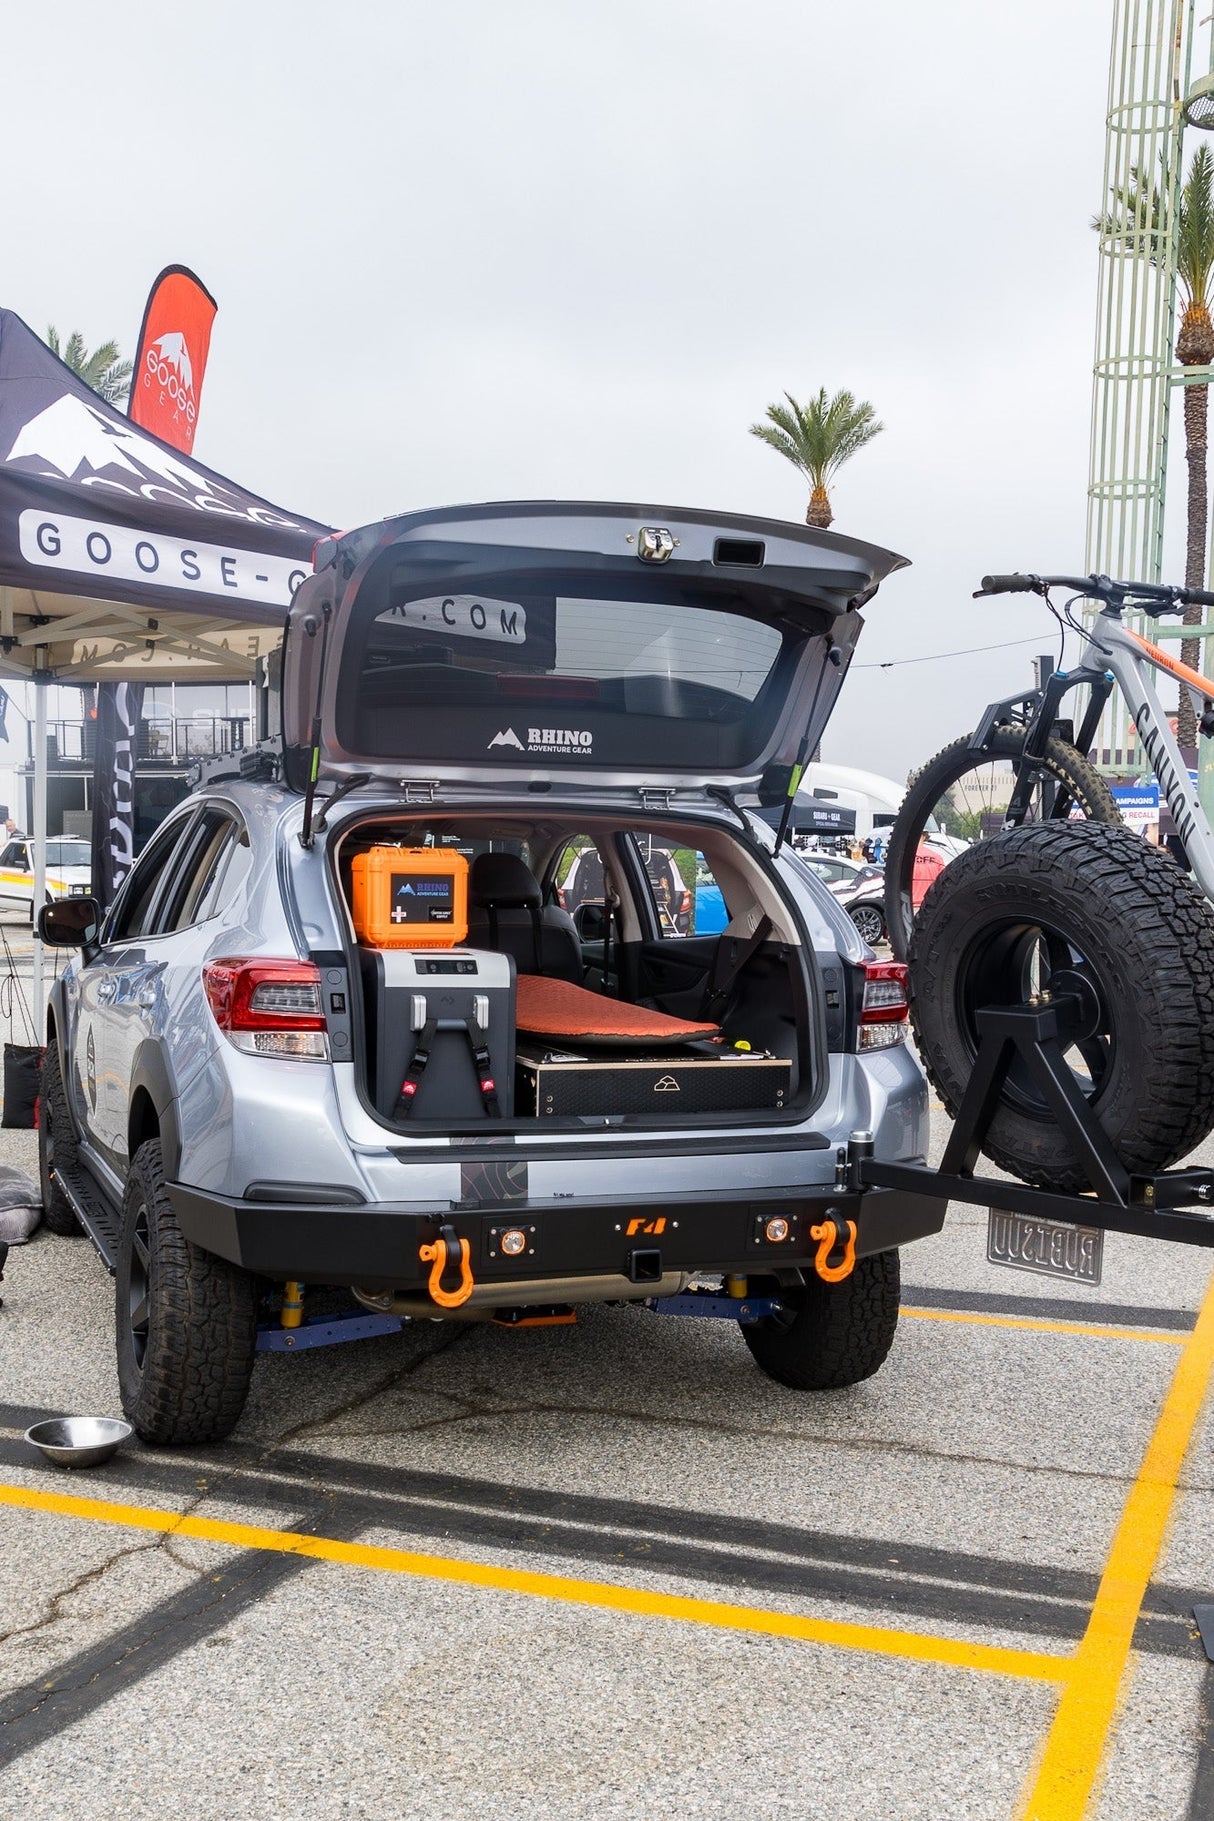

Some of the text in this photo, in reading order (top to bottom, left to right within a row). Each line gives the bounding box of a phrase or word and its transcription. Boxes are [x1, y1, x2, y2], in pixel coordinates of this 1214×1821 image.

[528, 728, 592, 746] RHINO
[528, 745, 571, 753] ADVENTURE
[1136, 702, 1196, 847] CANYON
[417, 883, 449, 892] RHINO
